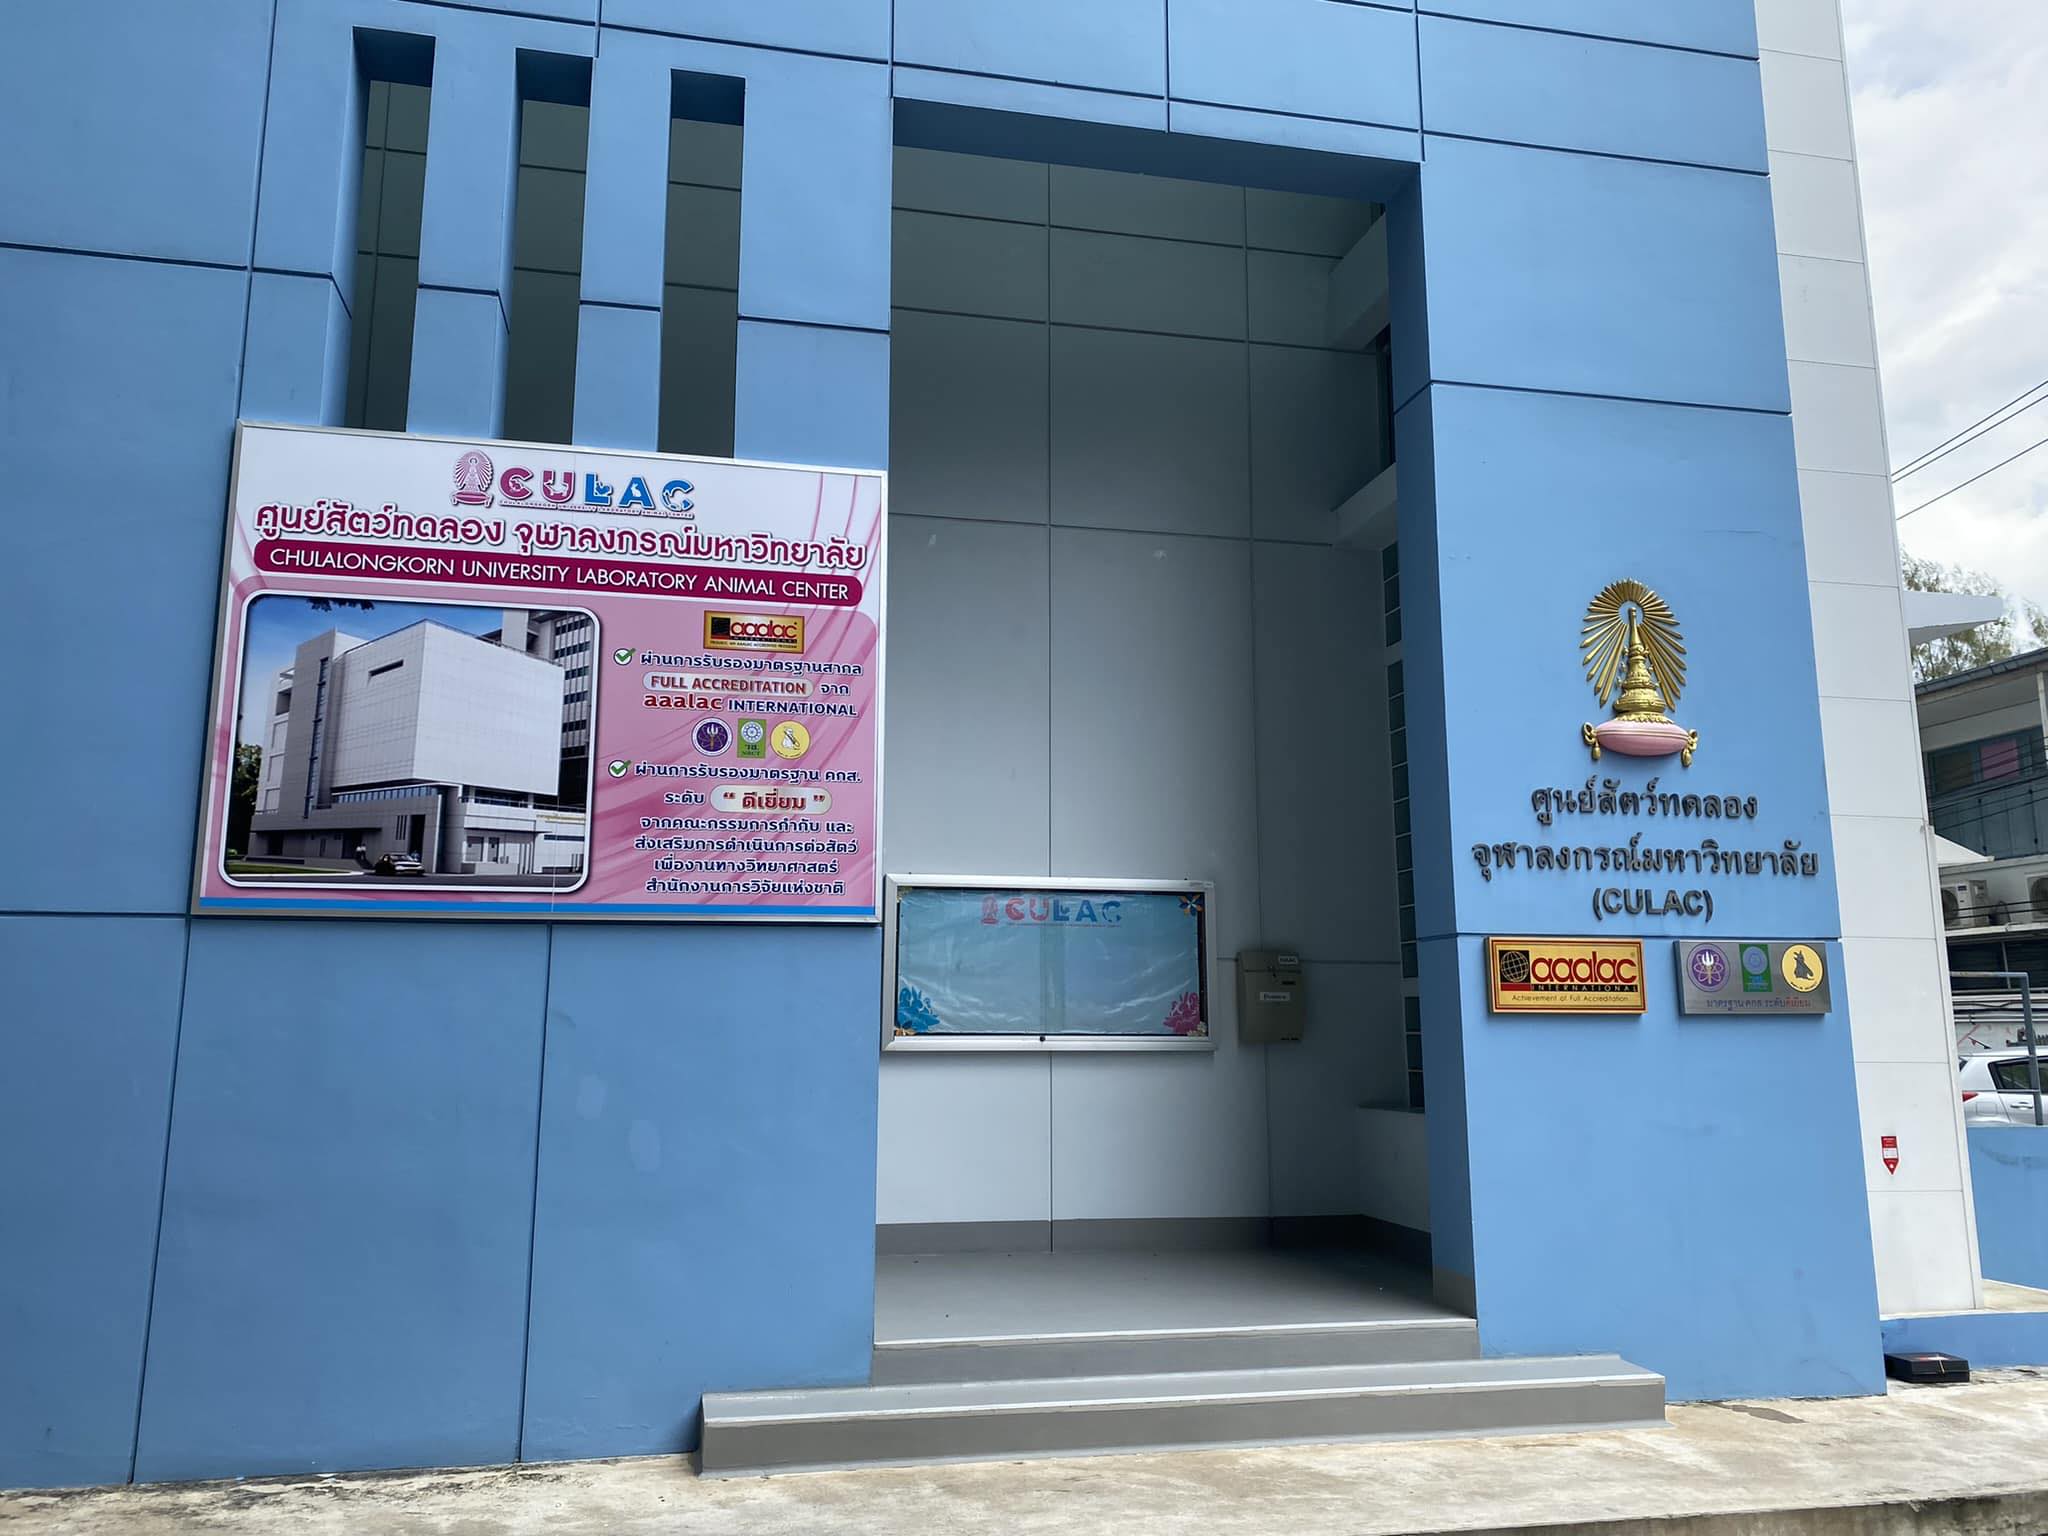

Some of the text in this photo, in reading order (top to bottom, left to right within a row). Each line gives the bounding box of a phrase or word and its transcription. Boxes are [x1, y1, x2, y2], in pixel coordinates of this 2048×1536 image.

[499, 467, 694, 511] CULAC
[254, 499, 866, 569] ศูนย์สัตว์ทดลอง จุฬาลงกรณ์มหาวิทยาลัย
[270, 547, 849, 601] CHULALONGKORN UNIVERSITY LABORATORY ANIMAL CENTER
[640, 648, 862, 675] ผ่านการรับรองมาตรฐานสากล
[650, 675, 849, 695] FULL ACCREDITATION จาก
[644, 693, 857, 715] aaalac INTERNATIONAL
[635, 760, 861, 783] ผ่านการรับรองมาตรฐาน คกส.
[664, 789, 705, 804] ระดับ
[1532, 775, 1758, 825] ศูนย์สัตว์ทดลอง
[640, 816, 854, 833] จากคณะกรรมการกำกับ และ
[635, 835, 858, 853] ส่งเสริมการดำเนินการต่อสัตว์
[654, 853, 838, 874] เพื่องานทางวิทยาศาสตร์
[1472, 833, 1819, 882] จุฬาลงกรณ์มหาวิทยาลัย
[646, 877, 844, 895] สำนักงานการวิจัยแห่งชาติ
[1005, 896, 1122, 923] CULAC
[1593, 887, 1714, 922] (CULAC)
[1531, 951, 1637, 983] aaalac
[1511, 993, 1557, 1002] Achievement
[1583, 994, 1629, 1002] Accreditation
[1531, 983, 1637, 992] INTERNATIONAL
